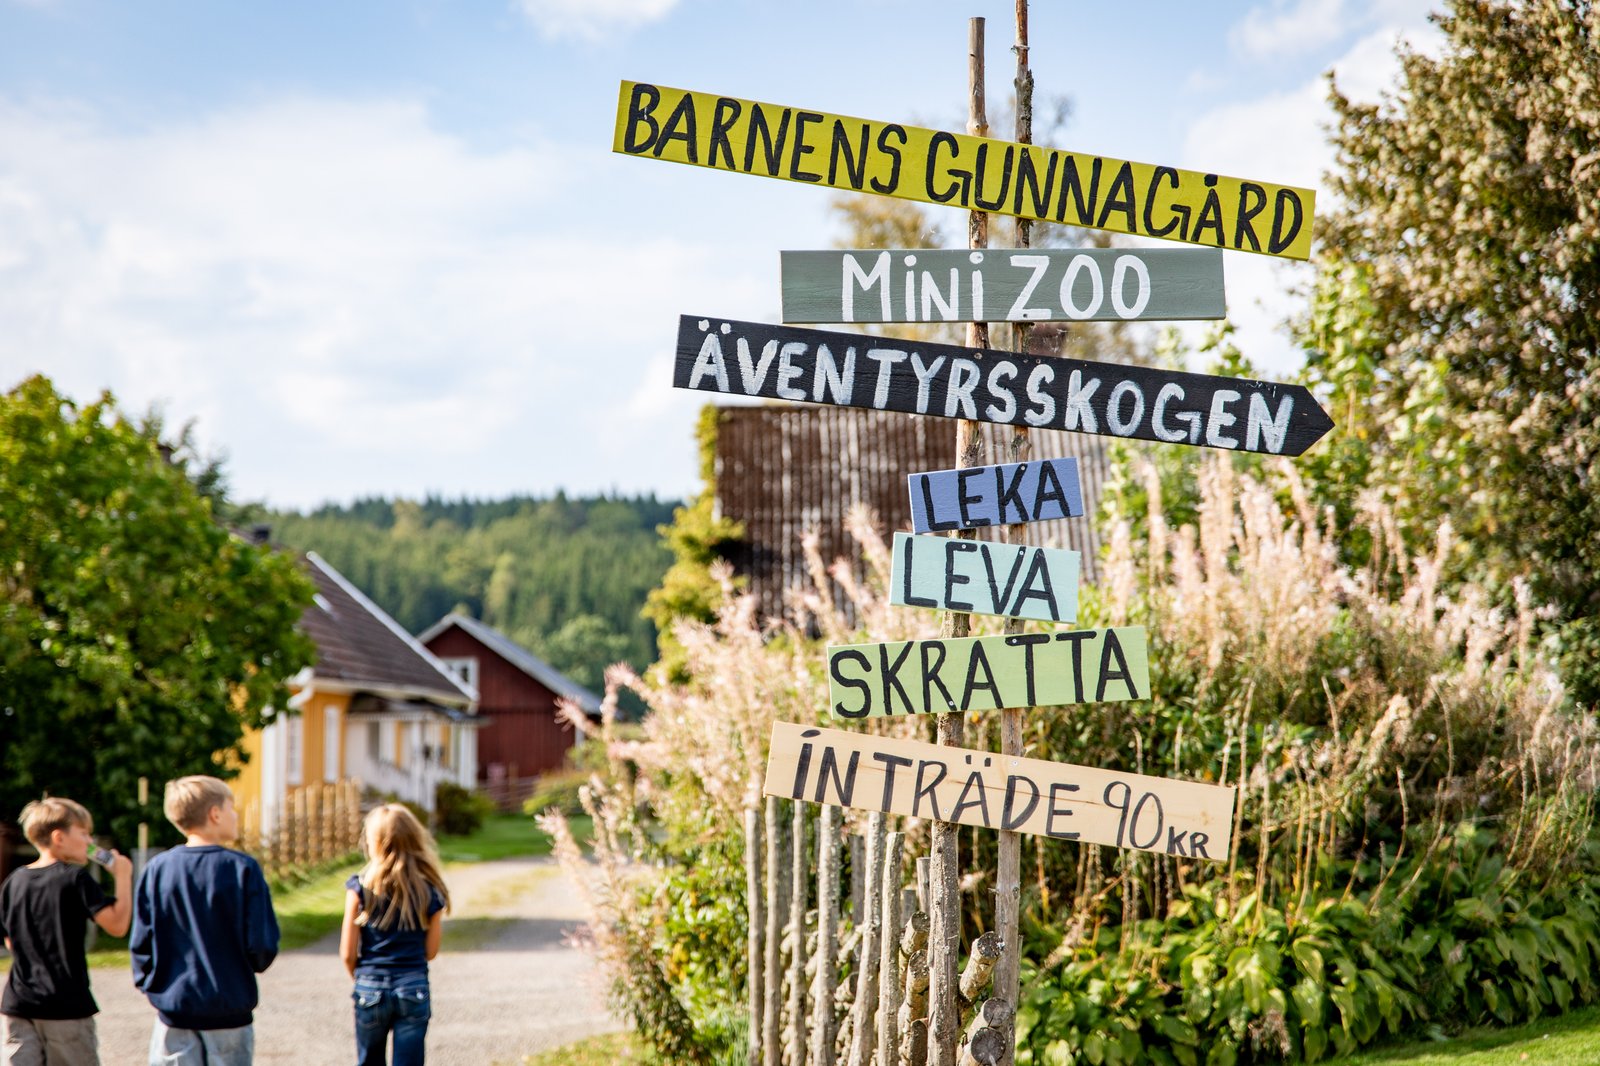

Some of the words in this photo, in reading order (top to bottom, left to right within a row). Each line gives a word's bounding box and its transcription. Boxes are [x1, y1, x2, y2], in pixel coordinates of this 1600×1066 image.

[623, 82, 907, 194] BARNENS
[925, 131, 1303, 254] GUNNAGÅRD
[1006, 254, 1151, 321] ZOO
[688, 319, 1296, 454] ÄVENTYRSSKOGEN
[920, 460, 1071, 531] LEKA
[903, 537, 1061, 621] LEVA
[830, 628, 1139, 719] SKRATTA
